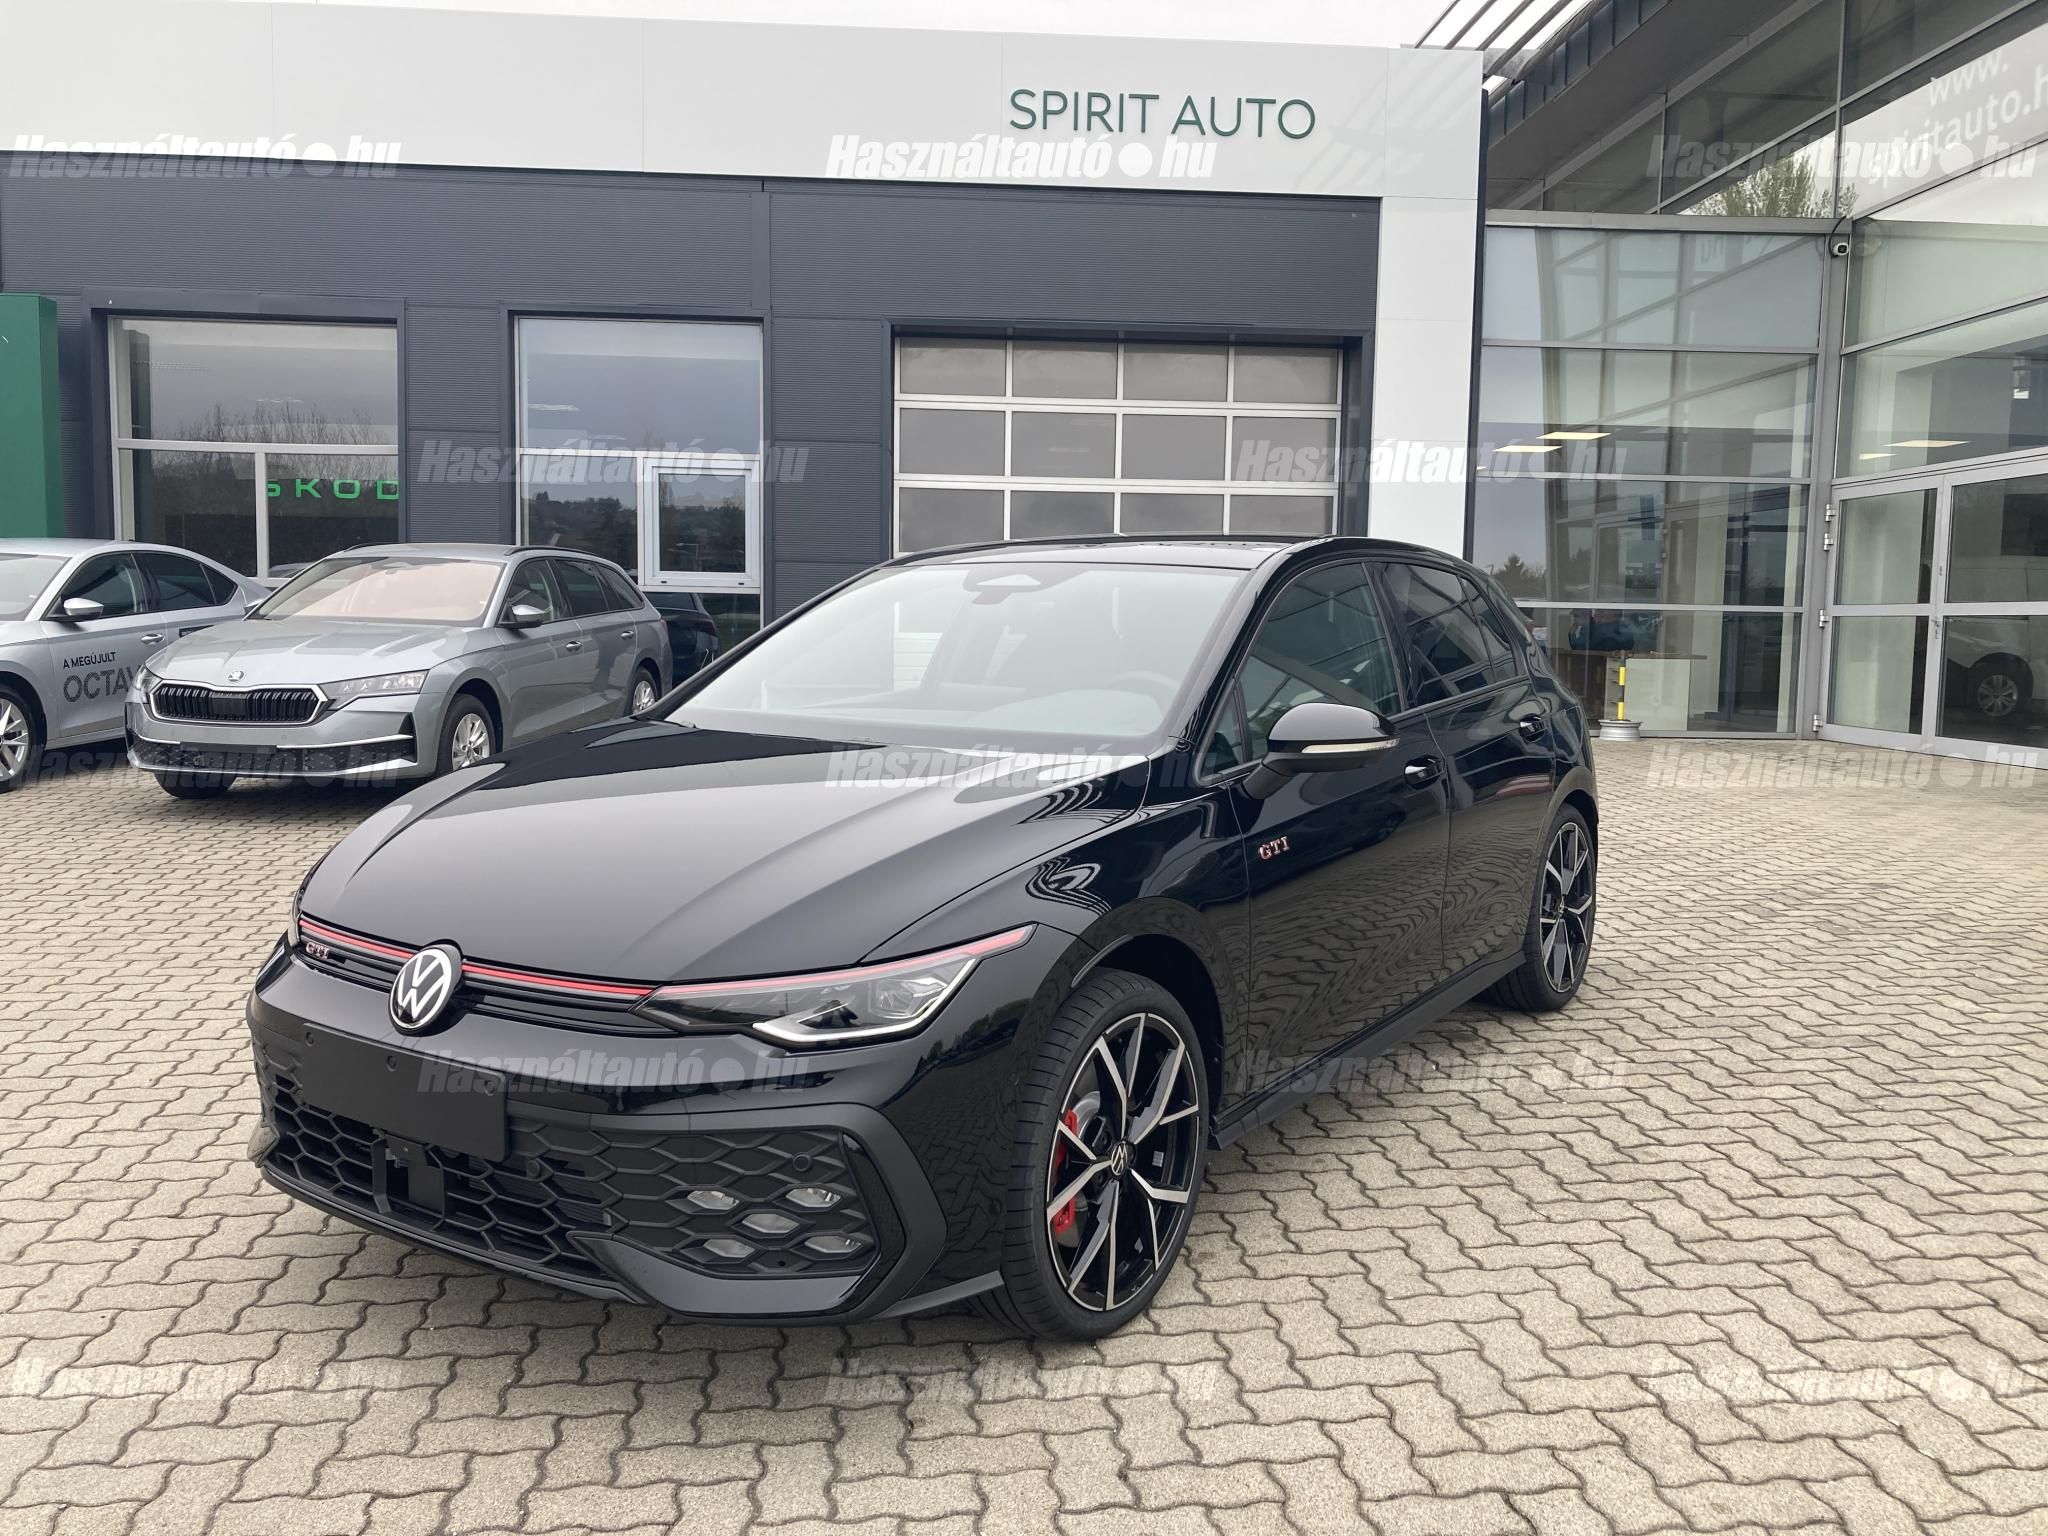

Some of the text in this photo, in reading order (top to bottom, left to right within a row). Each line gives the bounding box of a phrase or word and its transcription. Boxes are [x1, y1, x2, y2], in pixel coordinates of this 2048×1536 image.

[1009, 88, 1316, 140] SPIRIT AUTO
[63, 651, 116, 670] A MEGÚJULT
[1259, 836, 1290, 860] GTI
[305, 940, 330, 960] GTI
